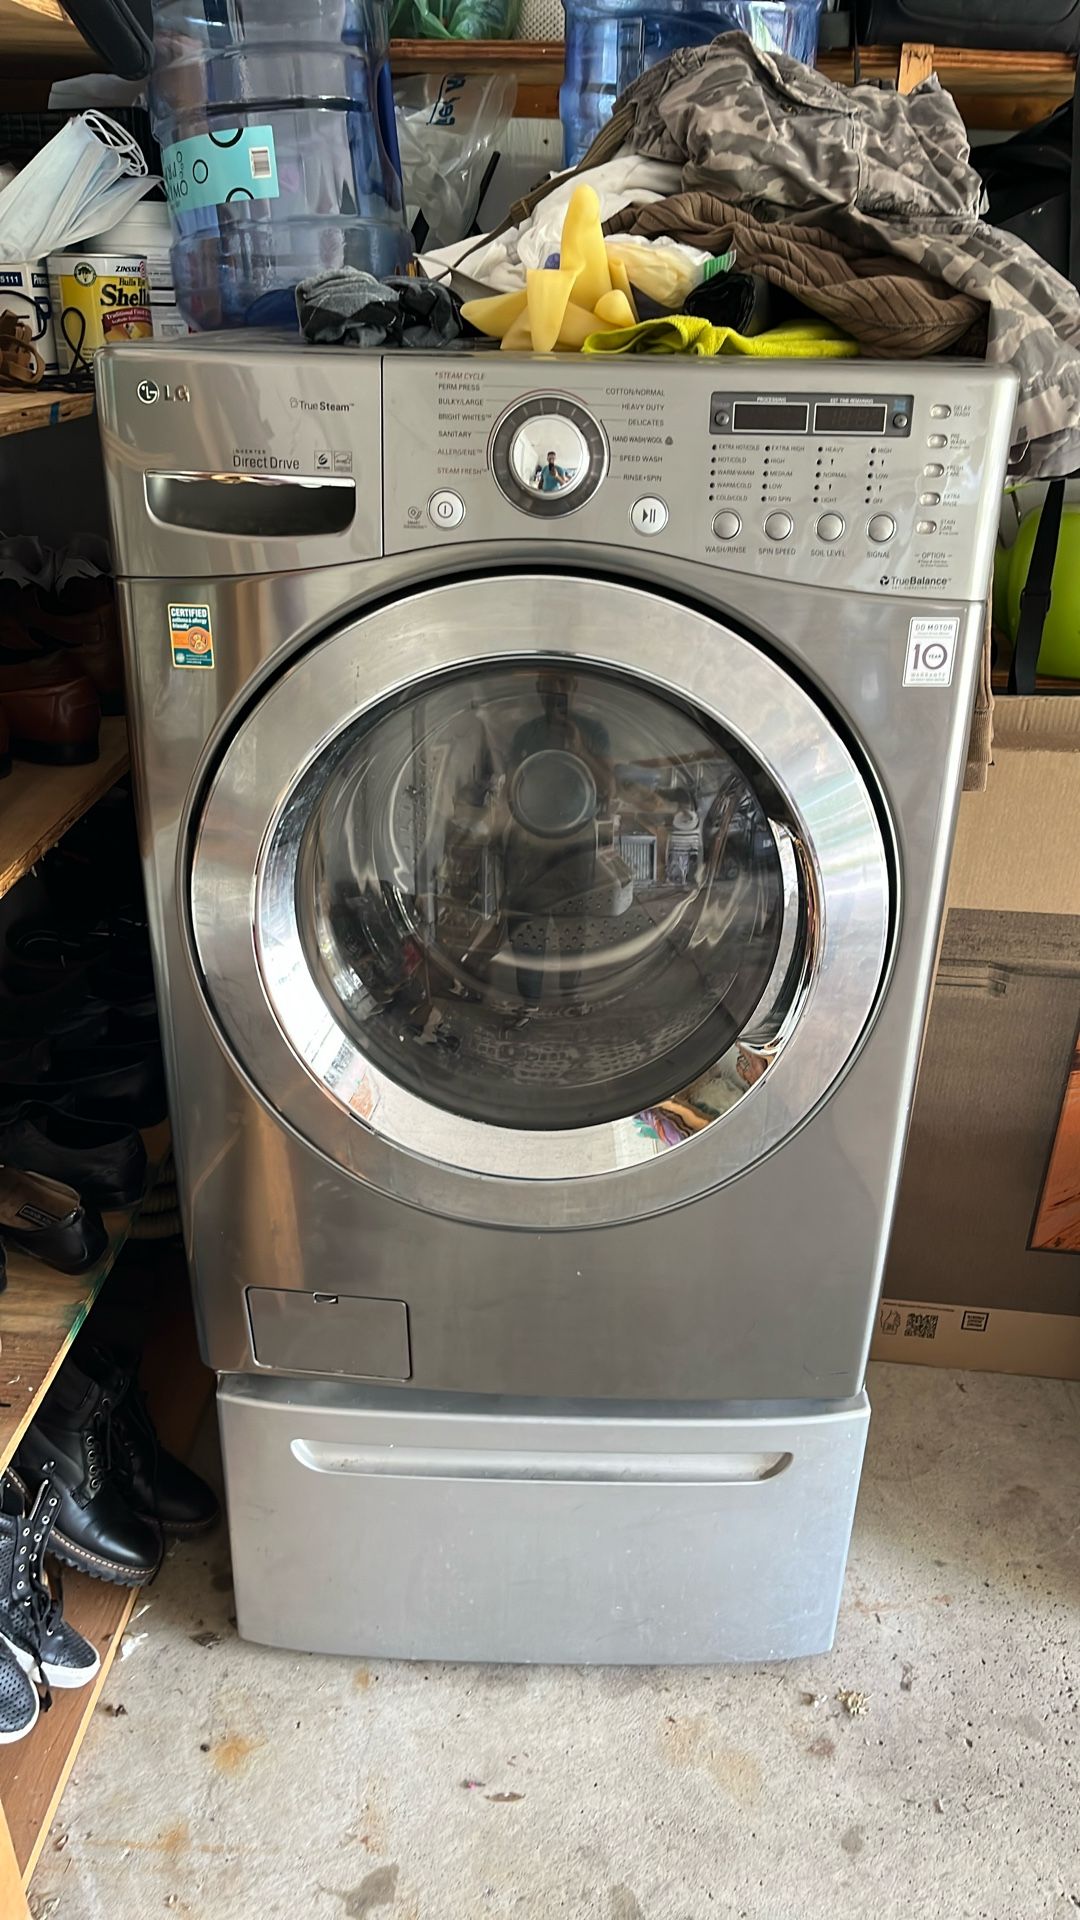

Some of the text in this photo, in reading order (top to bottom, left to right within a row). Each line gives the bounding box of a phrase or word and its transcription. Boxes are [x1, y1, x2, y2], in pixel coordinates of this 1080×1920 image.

[464, 372, 485, 381] CYCLE
[438, 383, 481, 391] PERM PRESS
[438, 397, 484, 407] BULKY/LARGE
[621, 403, 665, 411] HEAVY DUTY
[438, 413, 461, 421] BRIGHT
[627, 418, 665, 427] DELICATES
[438, 430, 472, 439] SANITARY
[233, 455, 268, 469] Direct
[270, 456, 300, 470] Drive
[619, 454, 663, 463] SPEED WASH
[717, 456, 747, 464] HOT/COLD
[769, 469, 793, 477] MEDIUM
[822, 470, 848, 478] NORMAL
[875, 472, 889, 480] LOW
[704, 545, 747, 554] WASH/RINSE
[758, 547, 797, 555] SPIN SPEED
[810, 549, 846, 557] SOIL LEVEL
[866, 551, 890, 559] SIGNAL
[921, 551, 946, 559] OPTION
[171, 607, 207, 617] CERTIFIED
[927, 623, 953, 631] MOTOR
[912, 643, 948, 671] 10
